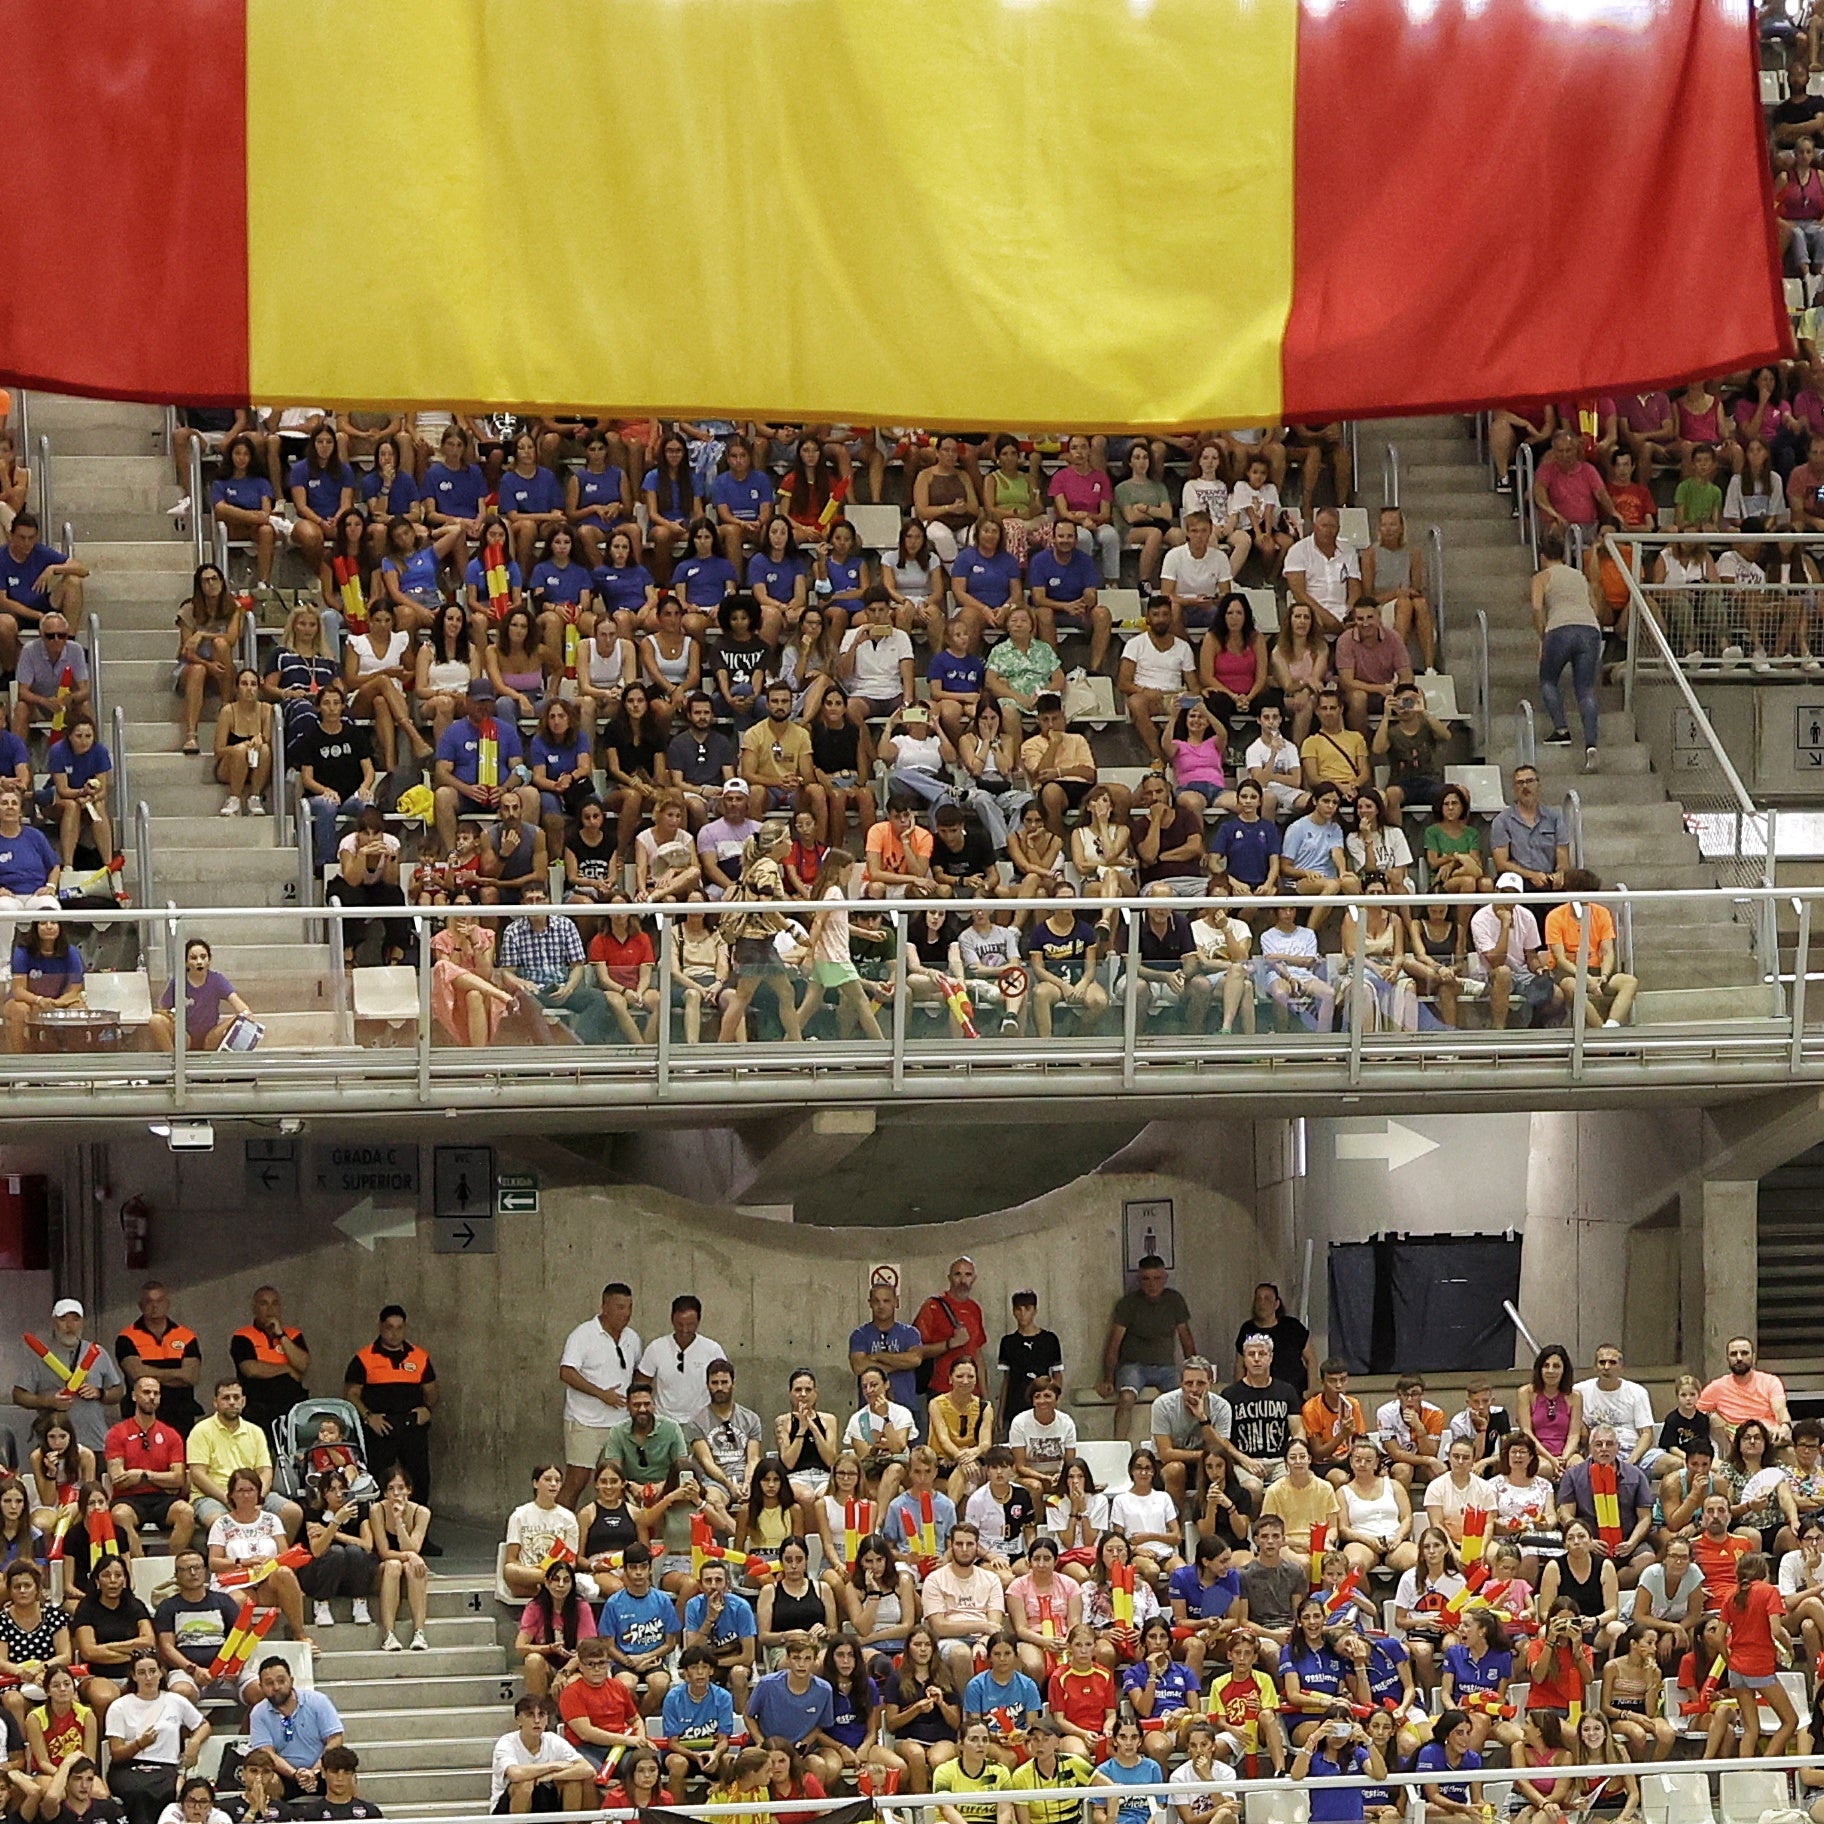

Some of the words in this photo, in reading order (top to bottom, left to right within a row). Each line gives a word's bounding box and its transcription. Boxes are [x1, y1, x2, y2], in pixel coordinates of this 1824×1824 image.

[283, 884, 297, 900] 2
[332, 1148, 383, 1168] GRADA
[386, 1148, 398, 1167] C
[342, 1173, 413, 1192] SUPERIOR
[1234, 1403, 1247, 1420] LA
[1248, 1400, 1289, 1420] CIUDAD
[1236, 1423, 1264, 1452] SIN
[1265, 1420, 1288, 1453] LEY
[468, 1594, 480, 1612] 4
[1304, 1672, 1339, 1685] gestimac
[500, 1681, 514, 1700] 3
